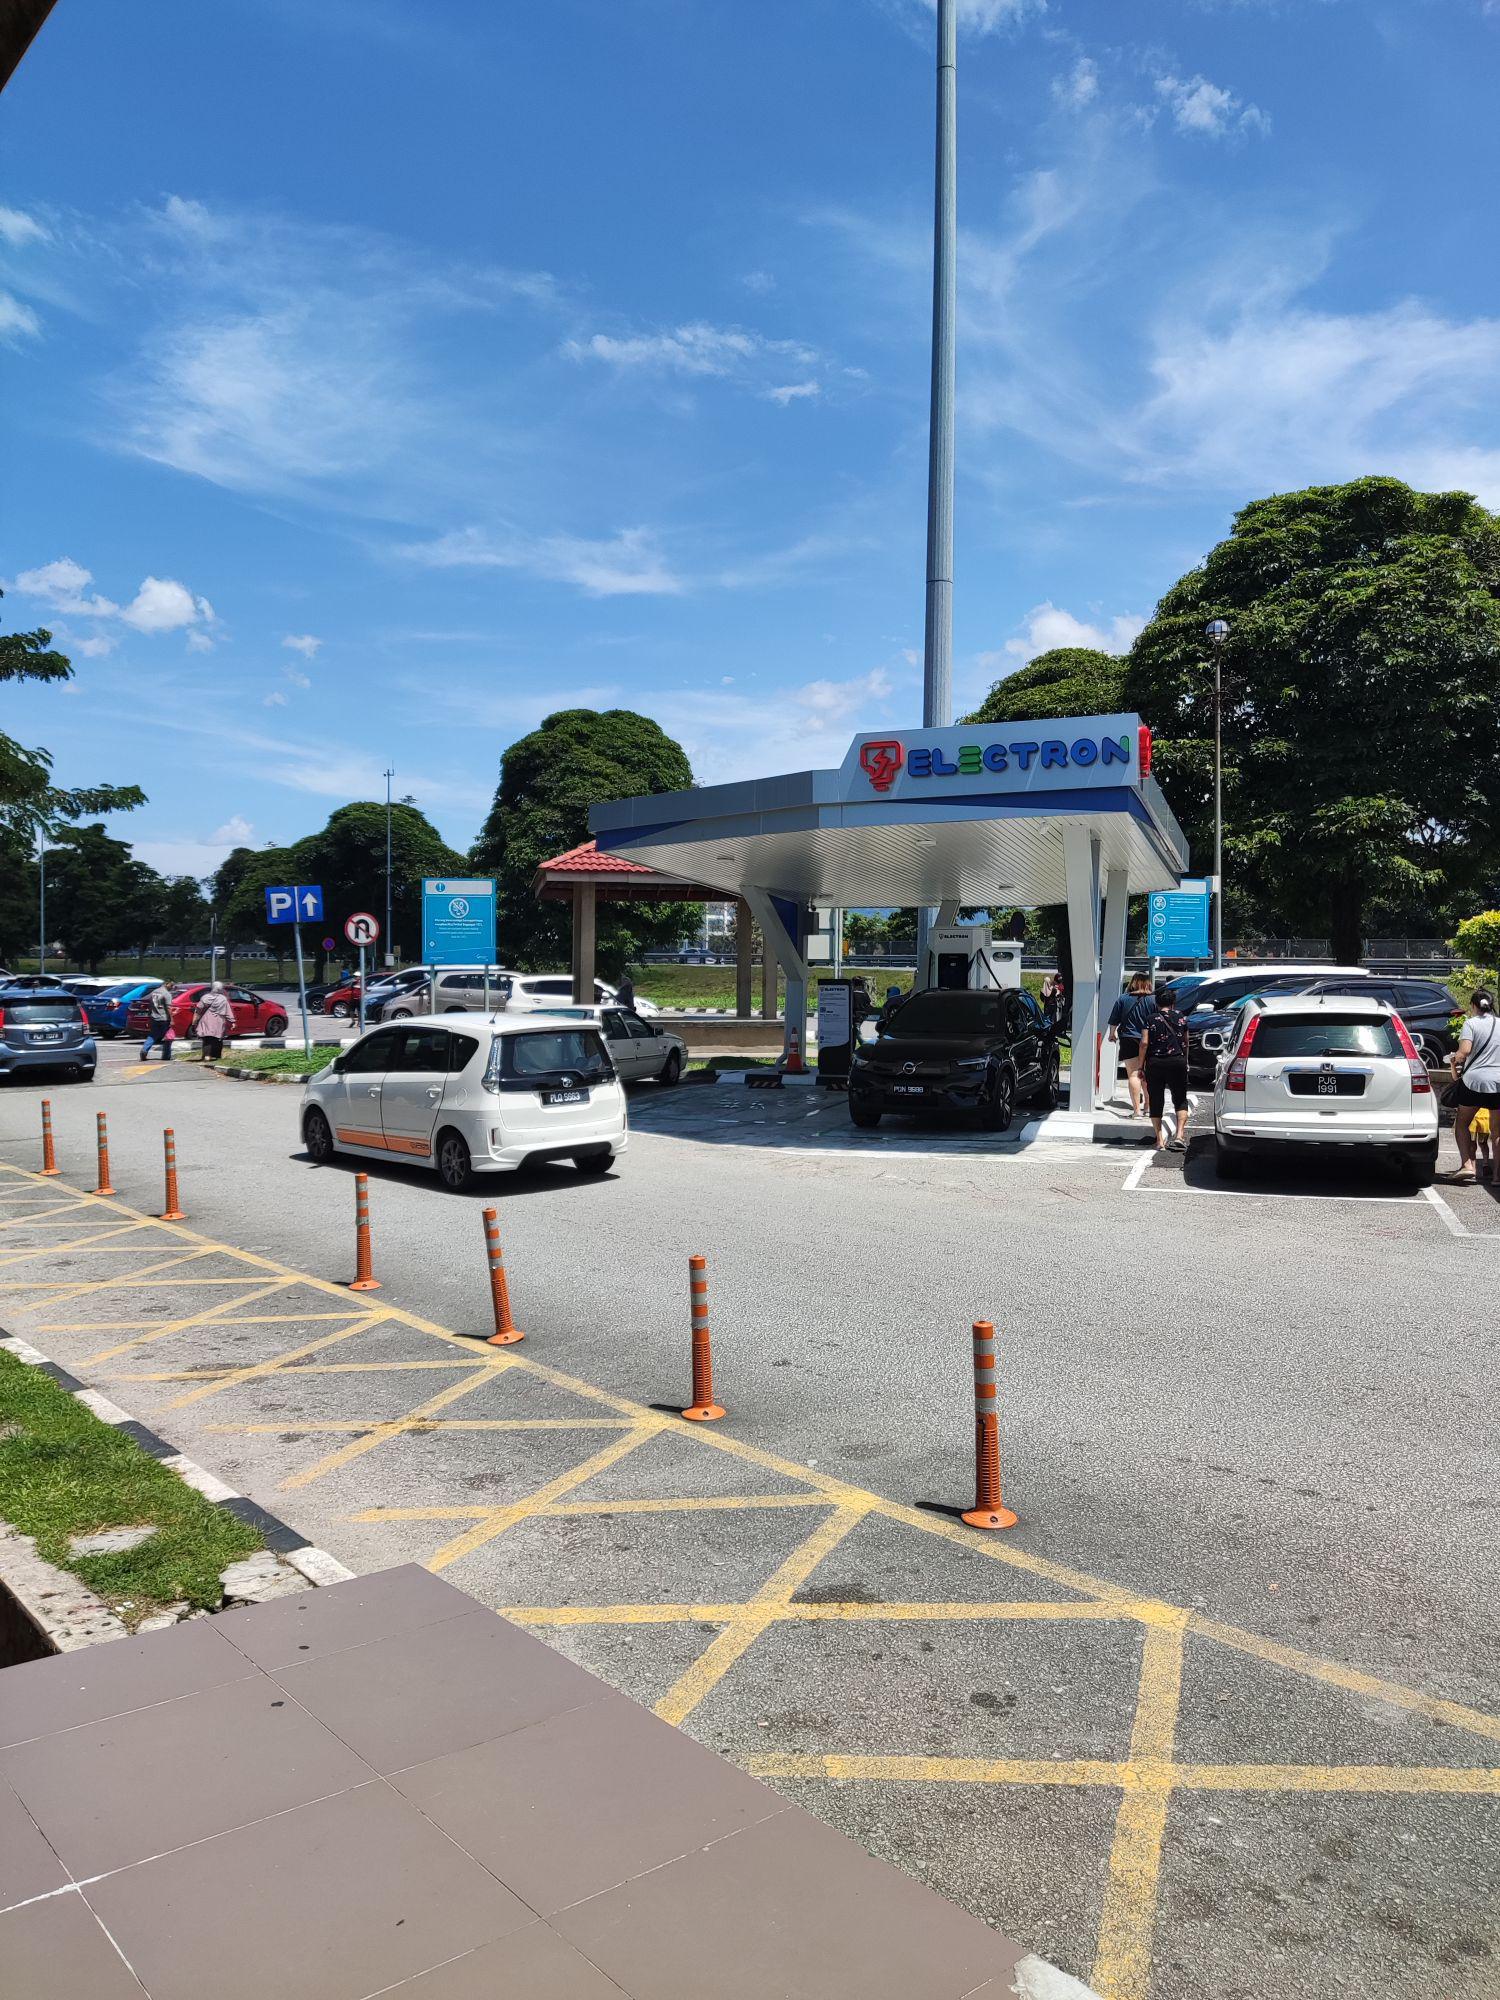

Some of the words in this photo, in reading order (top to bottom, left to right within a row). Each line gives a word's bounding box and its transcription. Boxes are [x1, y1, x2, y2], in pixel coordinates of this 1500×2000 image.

[907, 734, 1130, 777] ELECTRON
[270, 892, 292, 919] P
[1318, 1076, 1337, 1085] PJG
[1318, 1085, 1337, 1093] 1991
